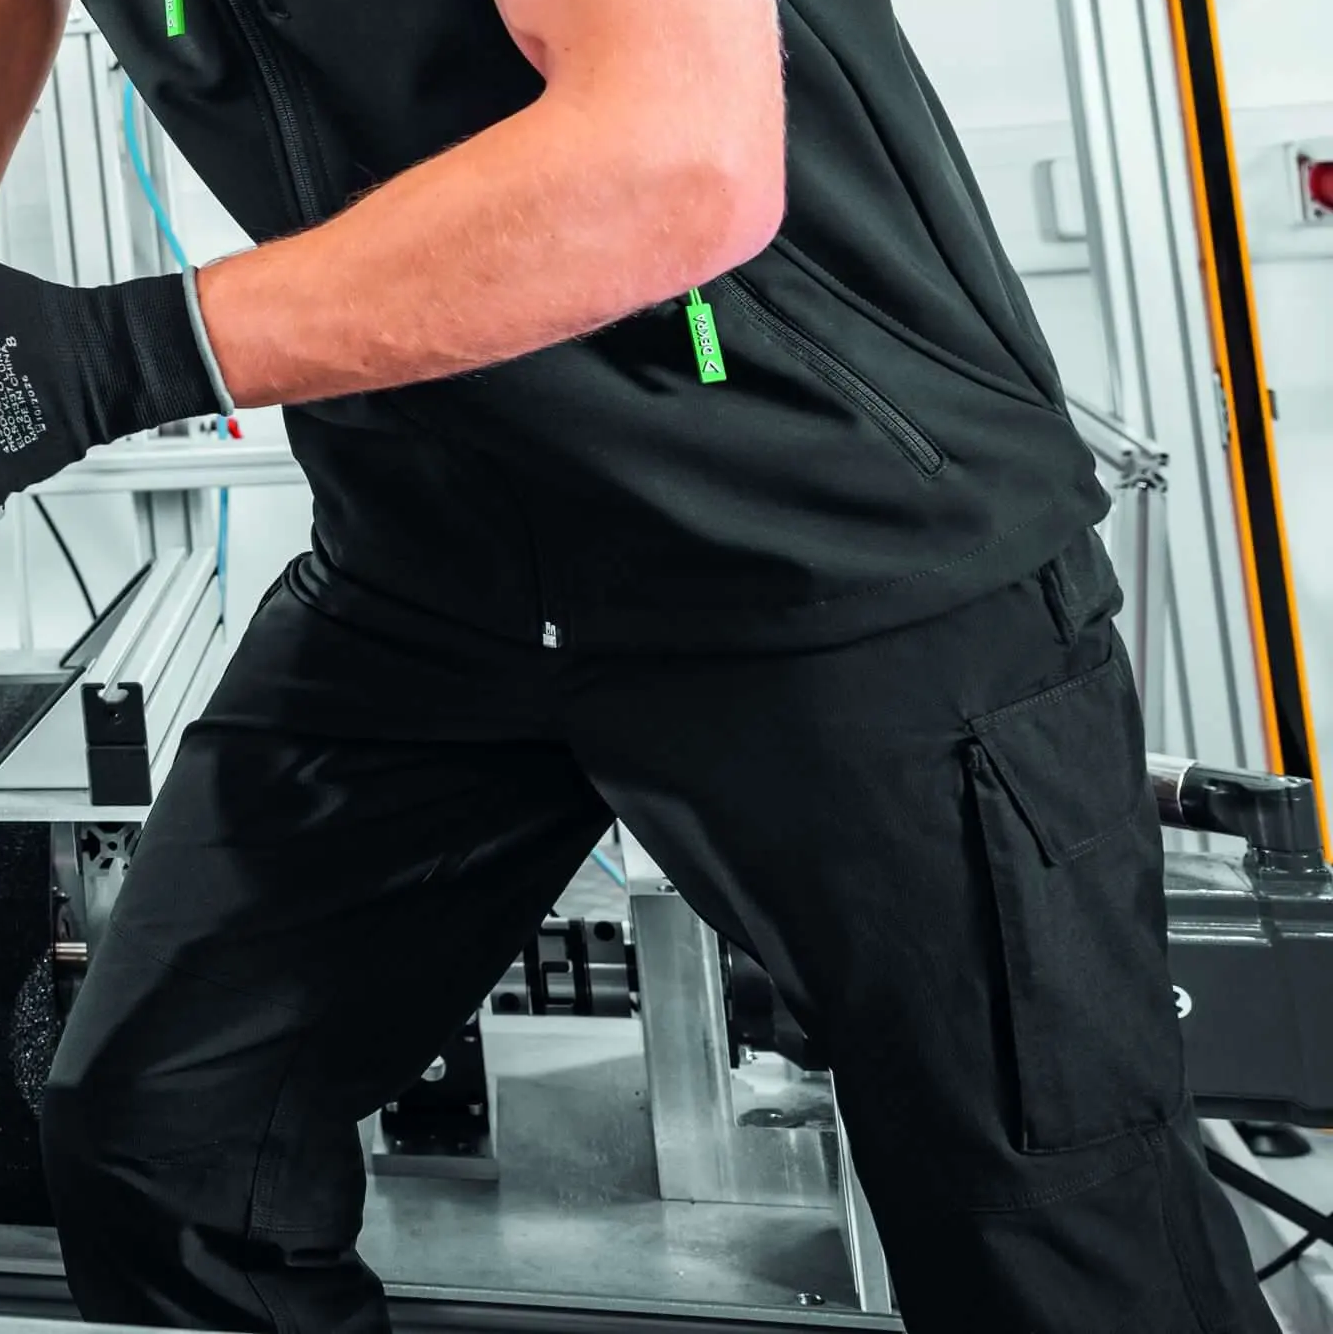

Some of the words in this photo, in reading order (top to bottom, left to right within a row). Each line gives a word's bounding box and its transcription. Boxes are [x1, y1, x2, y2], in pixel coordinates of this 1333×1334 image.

[5, 336, 17, 347] 8
[694, 313, 714, 356] DEKRA
[15, 390, 26, 405] IN
